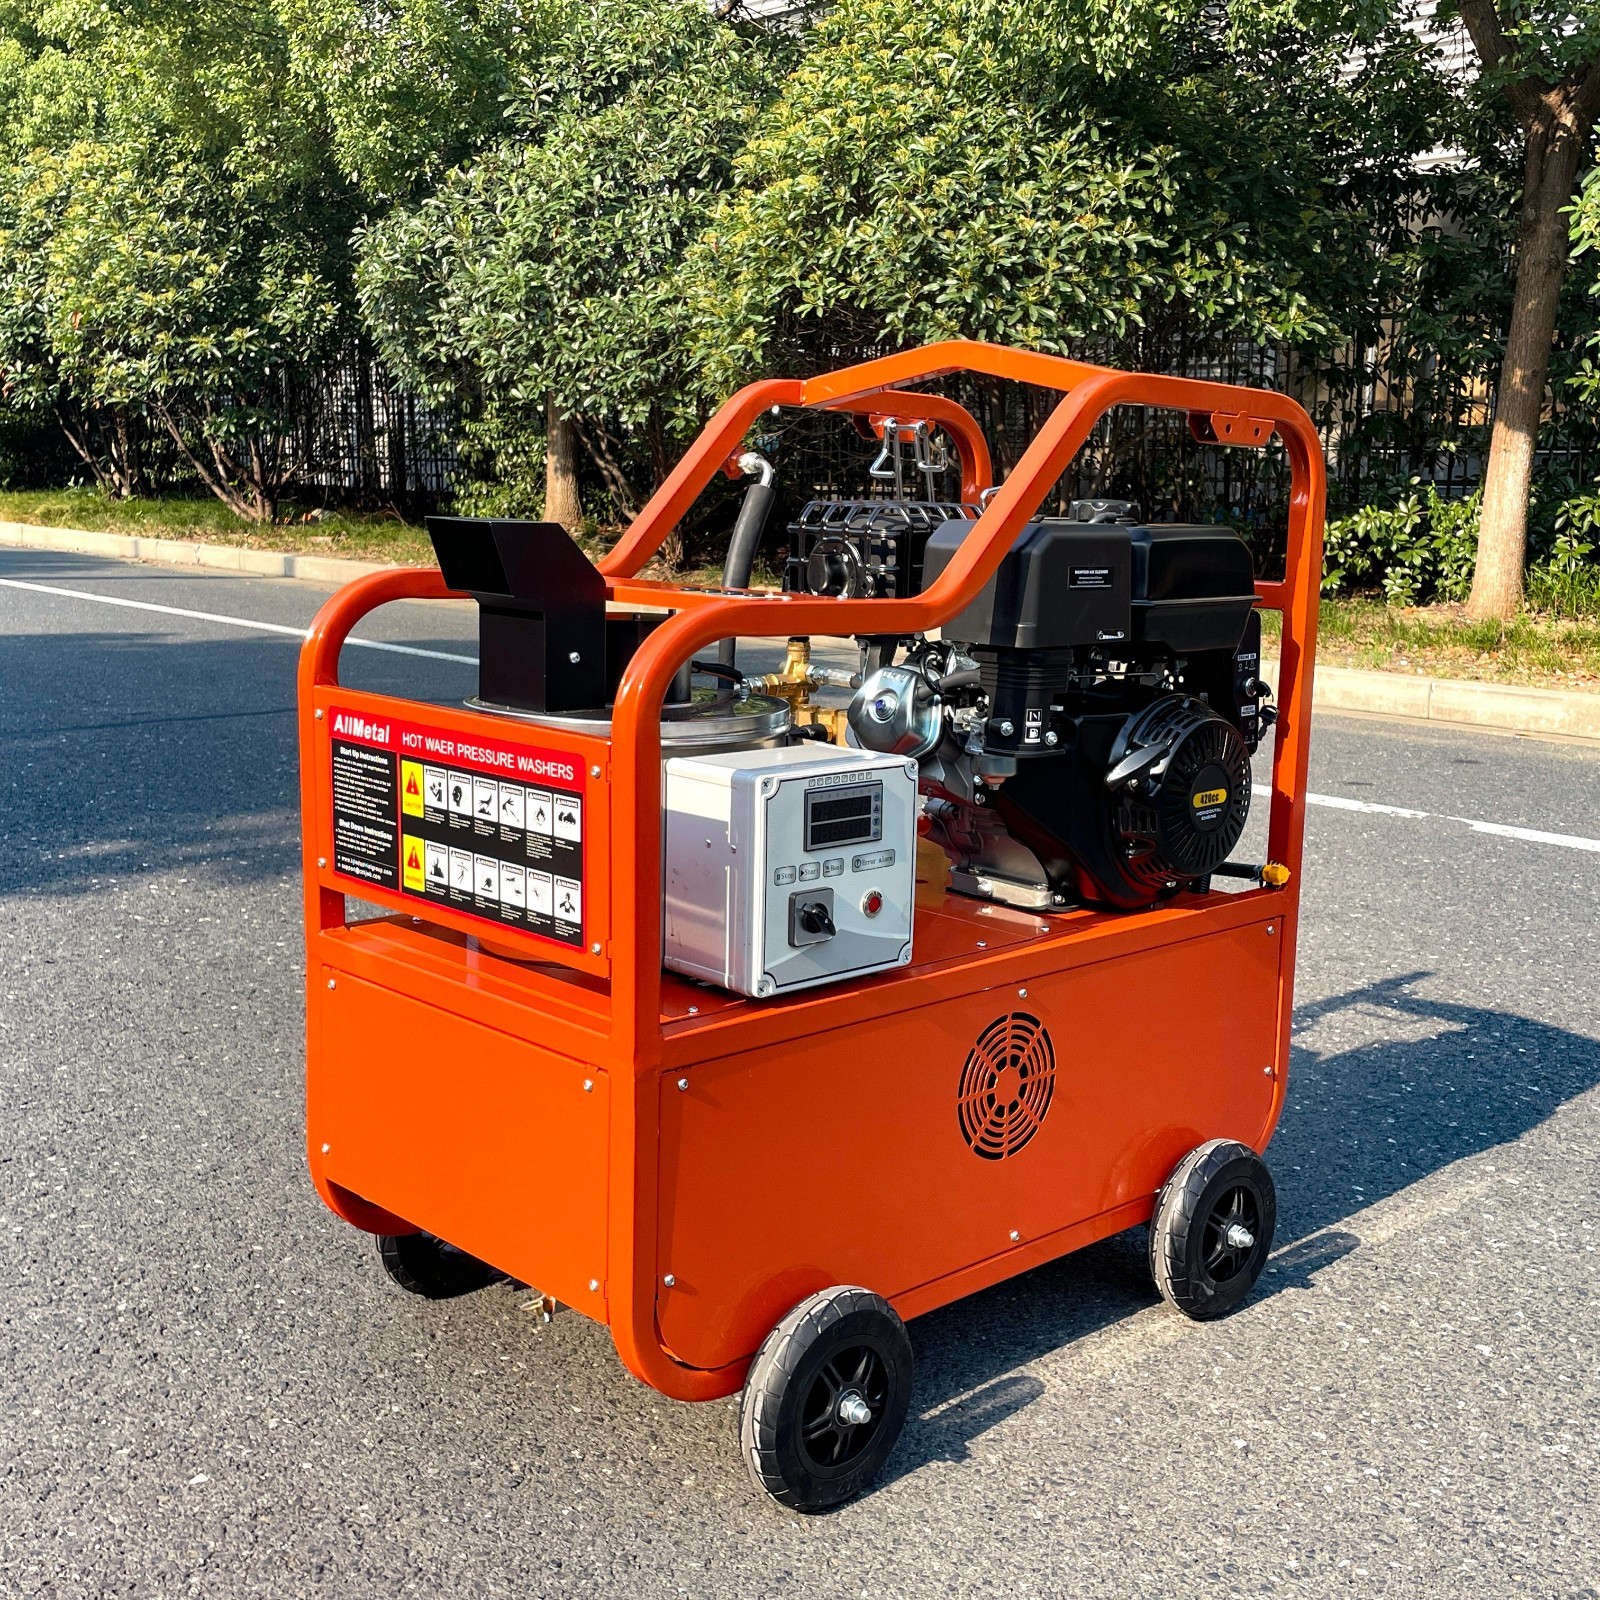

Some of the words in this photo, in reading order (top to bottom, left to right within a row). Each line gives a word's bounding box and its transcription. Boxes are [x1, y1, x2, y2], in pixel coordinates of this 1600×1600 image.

[334, 714, 390, 744] AllMetal
[340, 746, 352, 756] Start
[352, 749, 360, 760] Up
[402, 732, 422, 748] HOT
[425, 736, 454, 756] WAER
[458, 743, 514, 769] PRESSURE
[517, 756, 574, 780] WASHERS
[1201, 793, 1220, 804] 420cc
[350, 821, 364, 832] Down
[781, 872, 794, 880] Stop
[804, 867, 819, 876] Start
